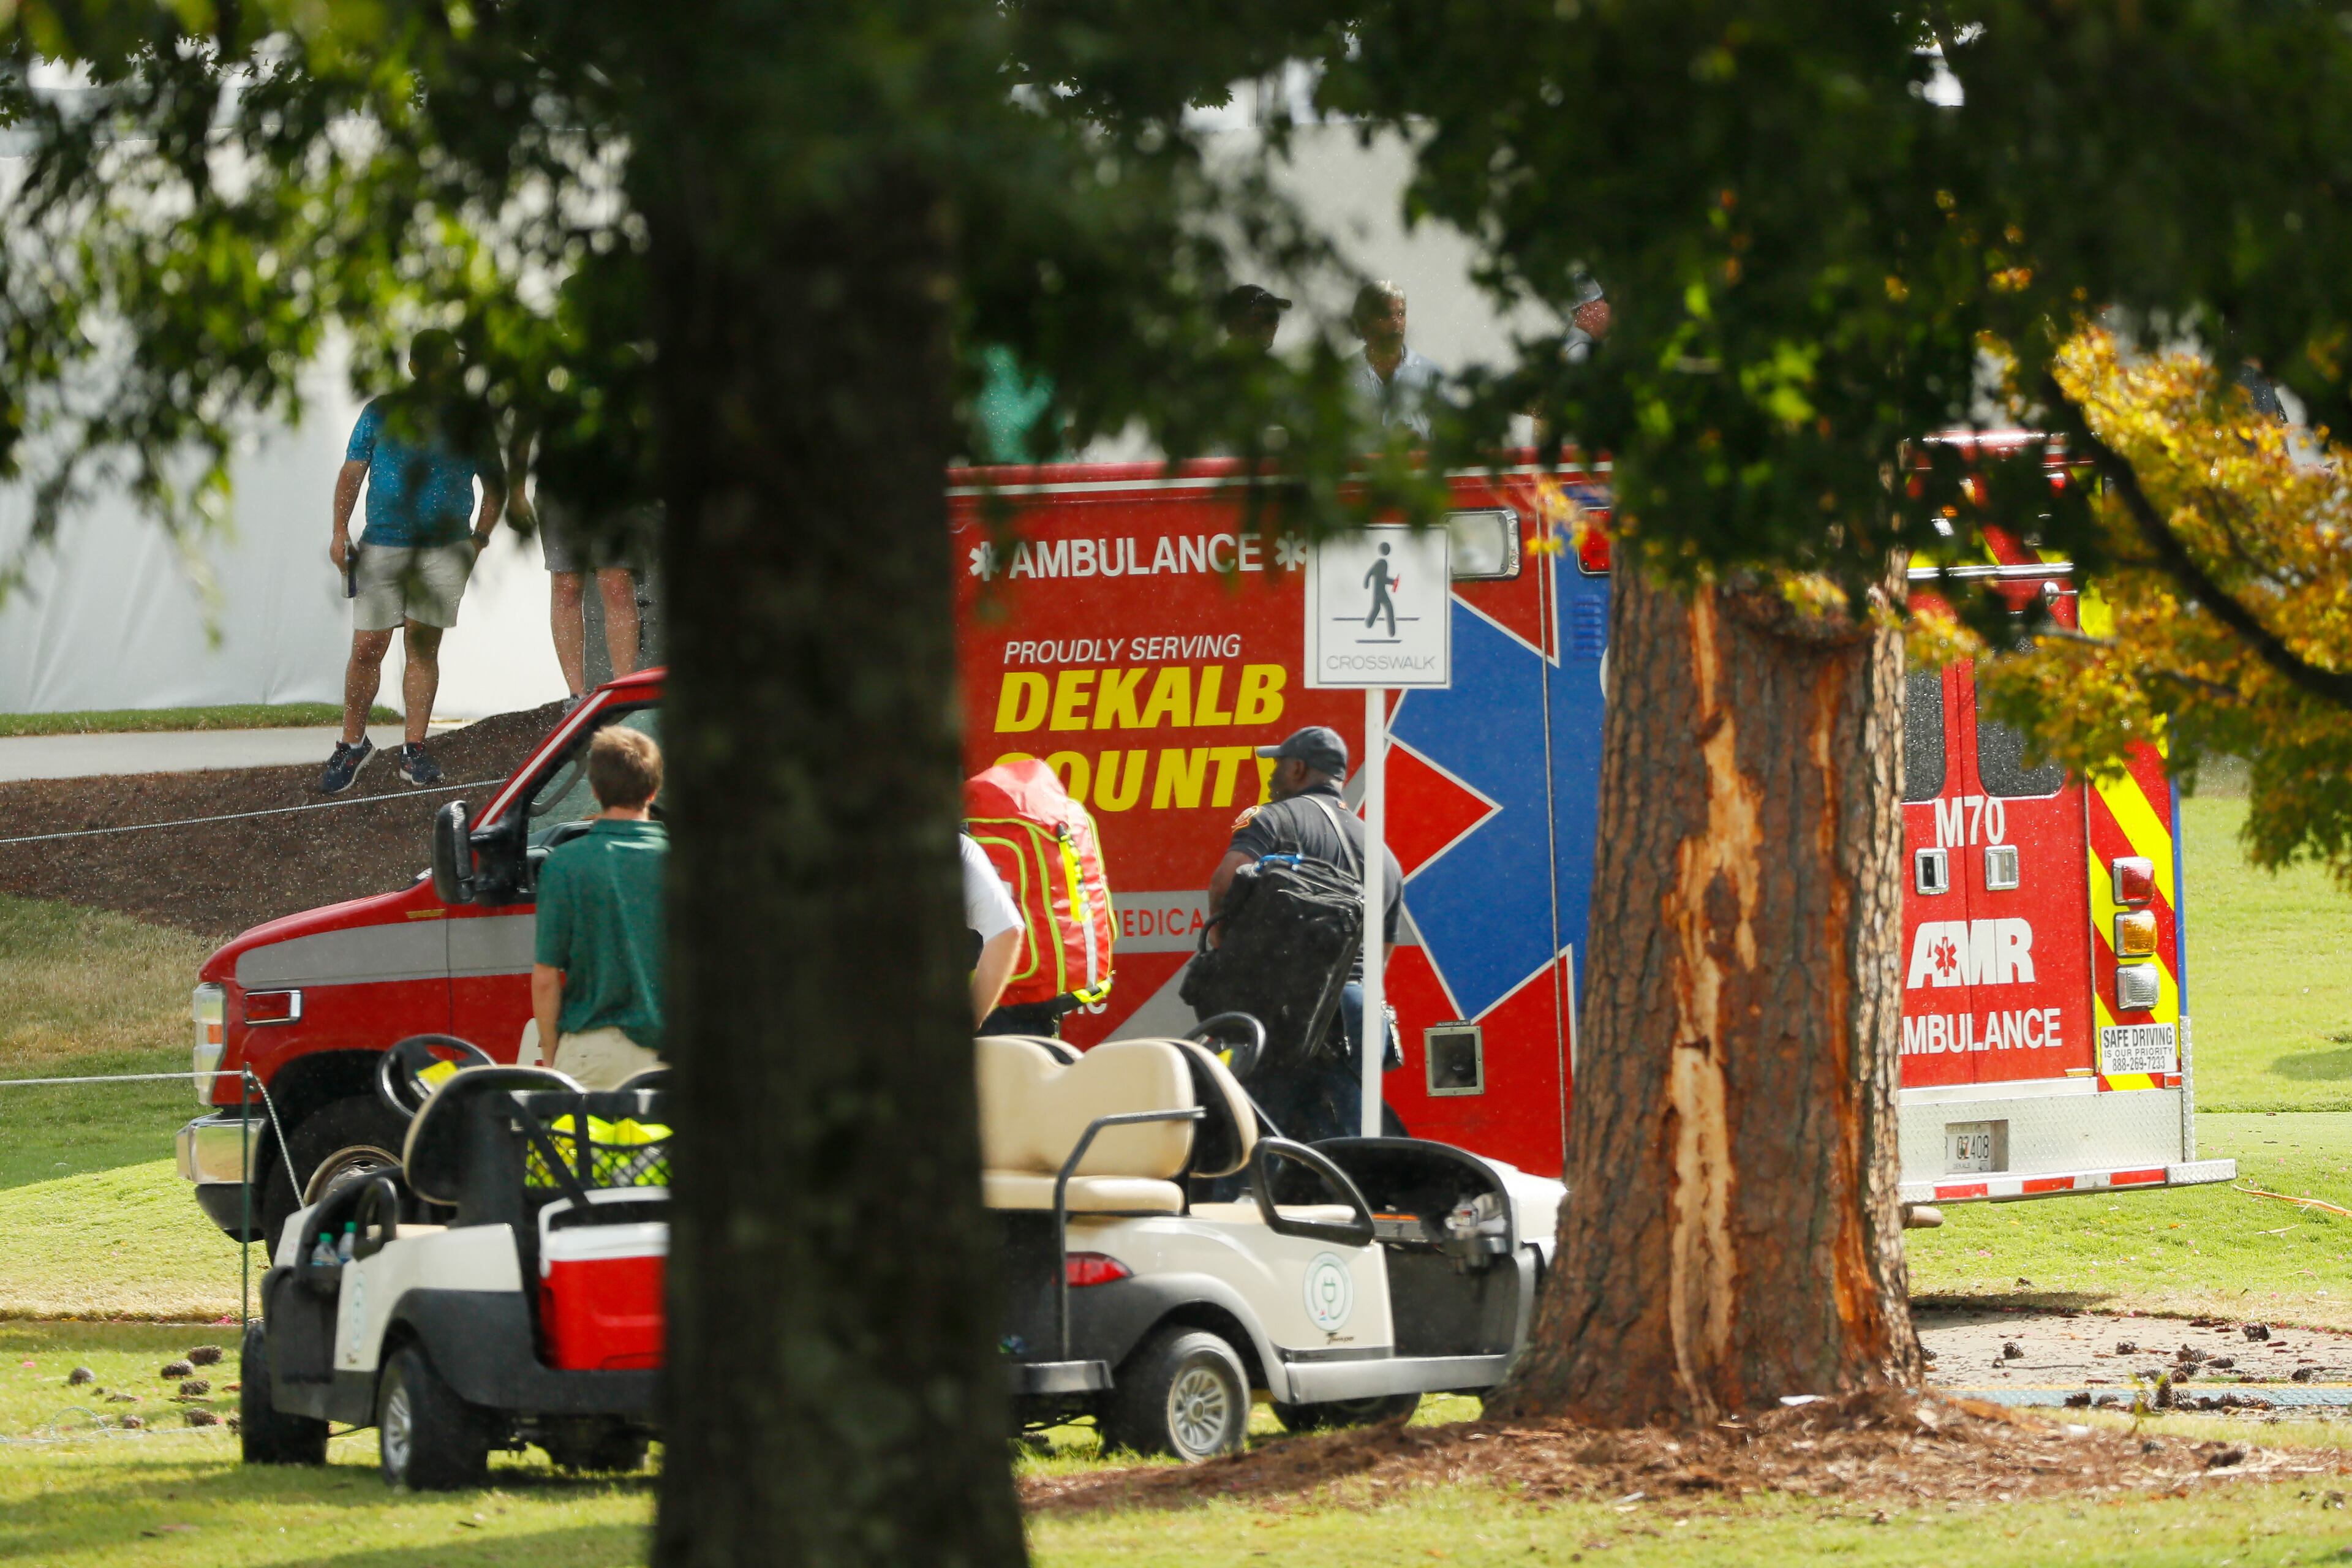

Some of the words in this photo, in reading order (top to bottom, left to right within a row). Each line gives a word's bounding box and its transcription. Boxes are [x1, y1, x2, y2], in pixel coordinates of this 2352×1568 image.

[1009, 533, 1263, 579] AMBULANCE
[1003, 638, 1125, 664] PROUDLY
[1129, 634, 1242, 662] SERVING
[1326, 655, 1435, 670] CROSSWALK
[994, 664, 1287, 733] DEKALB
[992, 745, 1276, 812] OUNTY
[1935, 796, 2005, 848] M70
[1114, 907, 1205, 937] EDICA
[1906, 918, 2035, 989] AMR
[1899, 1008, 2062, 1055] MBULANCE
[2103, 1029, 2129, 1048] SAFE
[2132, 1027, 2173, 1047] DRIVING
[2113, 1055, 2165, 1071] 888-269-7233
[2115, 1049, 2132, 1057] OUR
[2135, 1047, 2173, 1056] PRIORITY
